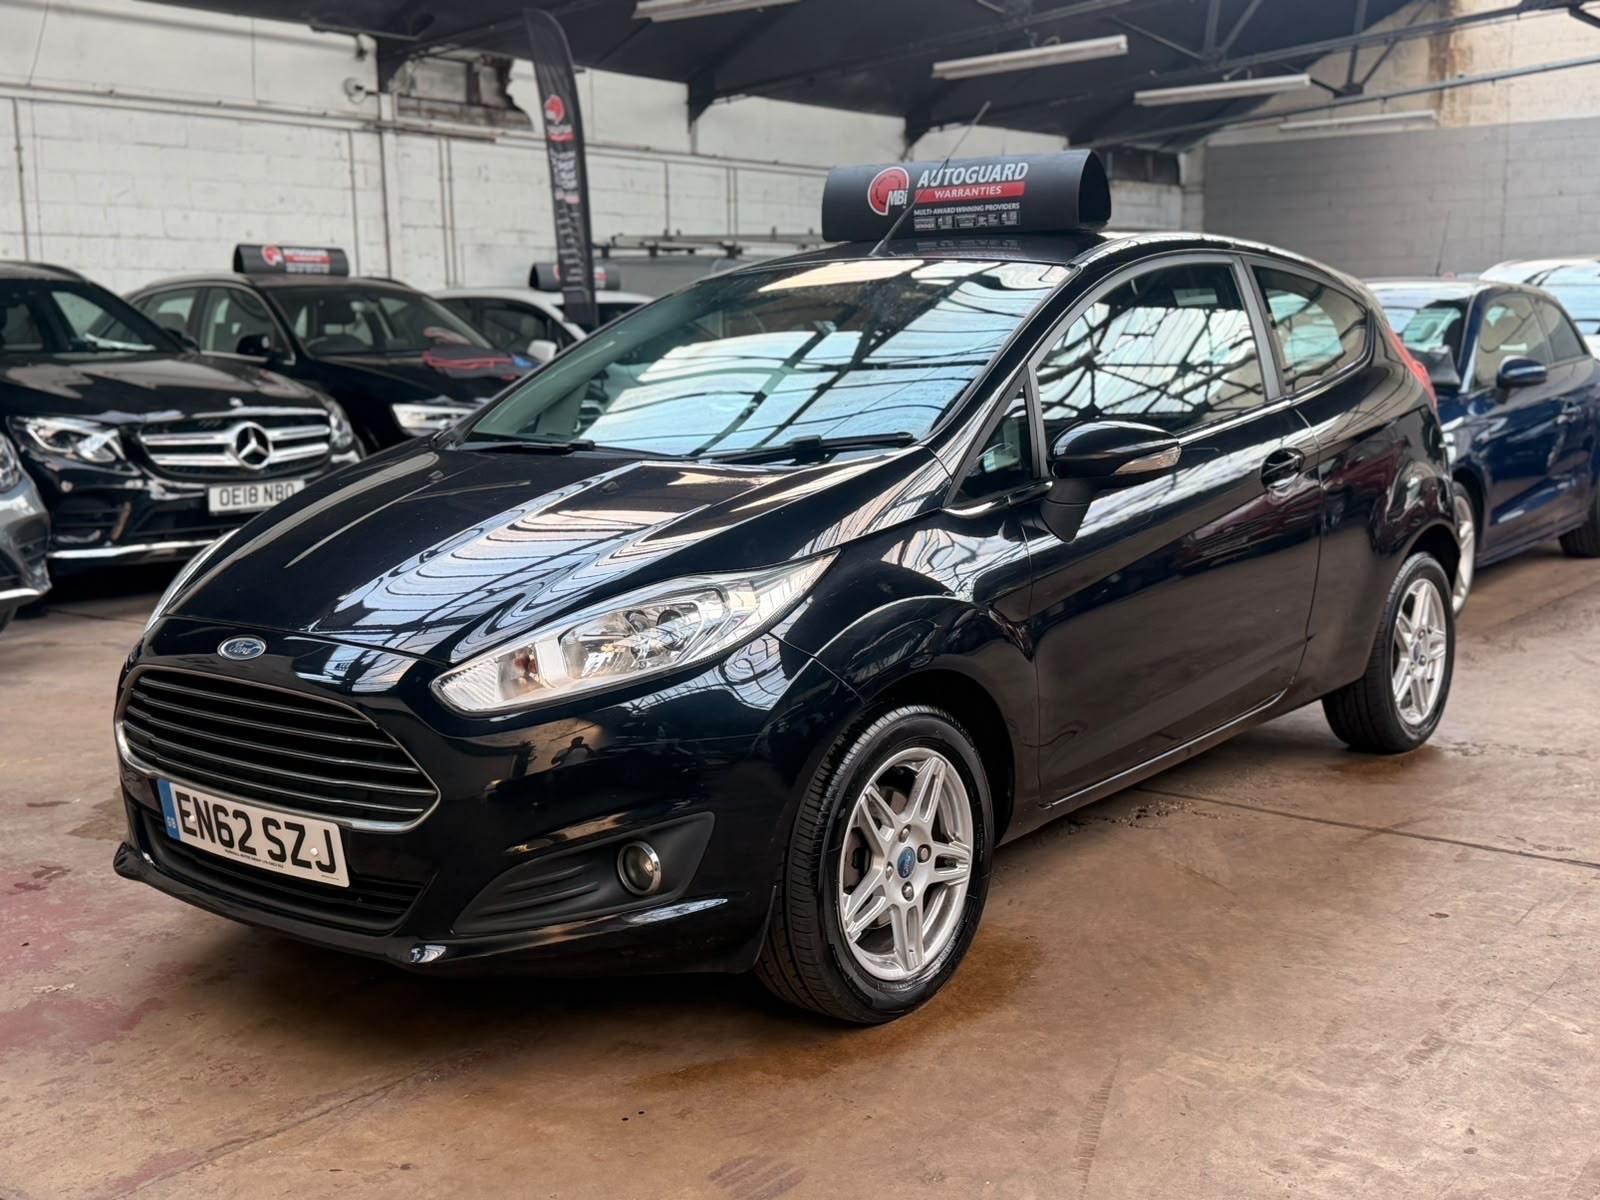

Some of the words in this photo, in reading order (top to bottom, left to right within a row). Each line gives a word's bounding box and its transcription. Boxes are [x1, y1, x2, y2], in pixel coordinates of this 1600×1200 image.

[917, 162, 1029, 188] AUTOGUARD
[934, 186, 1002, 199] WARRANTIES
[956, 204, 984, 214] WINNING
[985, 202, 1020, 212] PROVIDERS
[219, 486, 258, 507] OE18
[175, 790, 257, 856] EN62
[262, 816, 337, 874] SZJ
